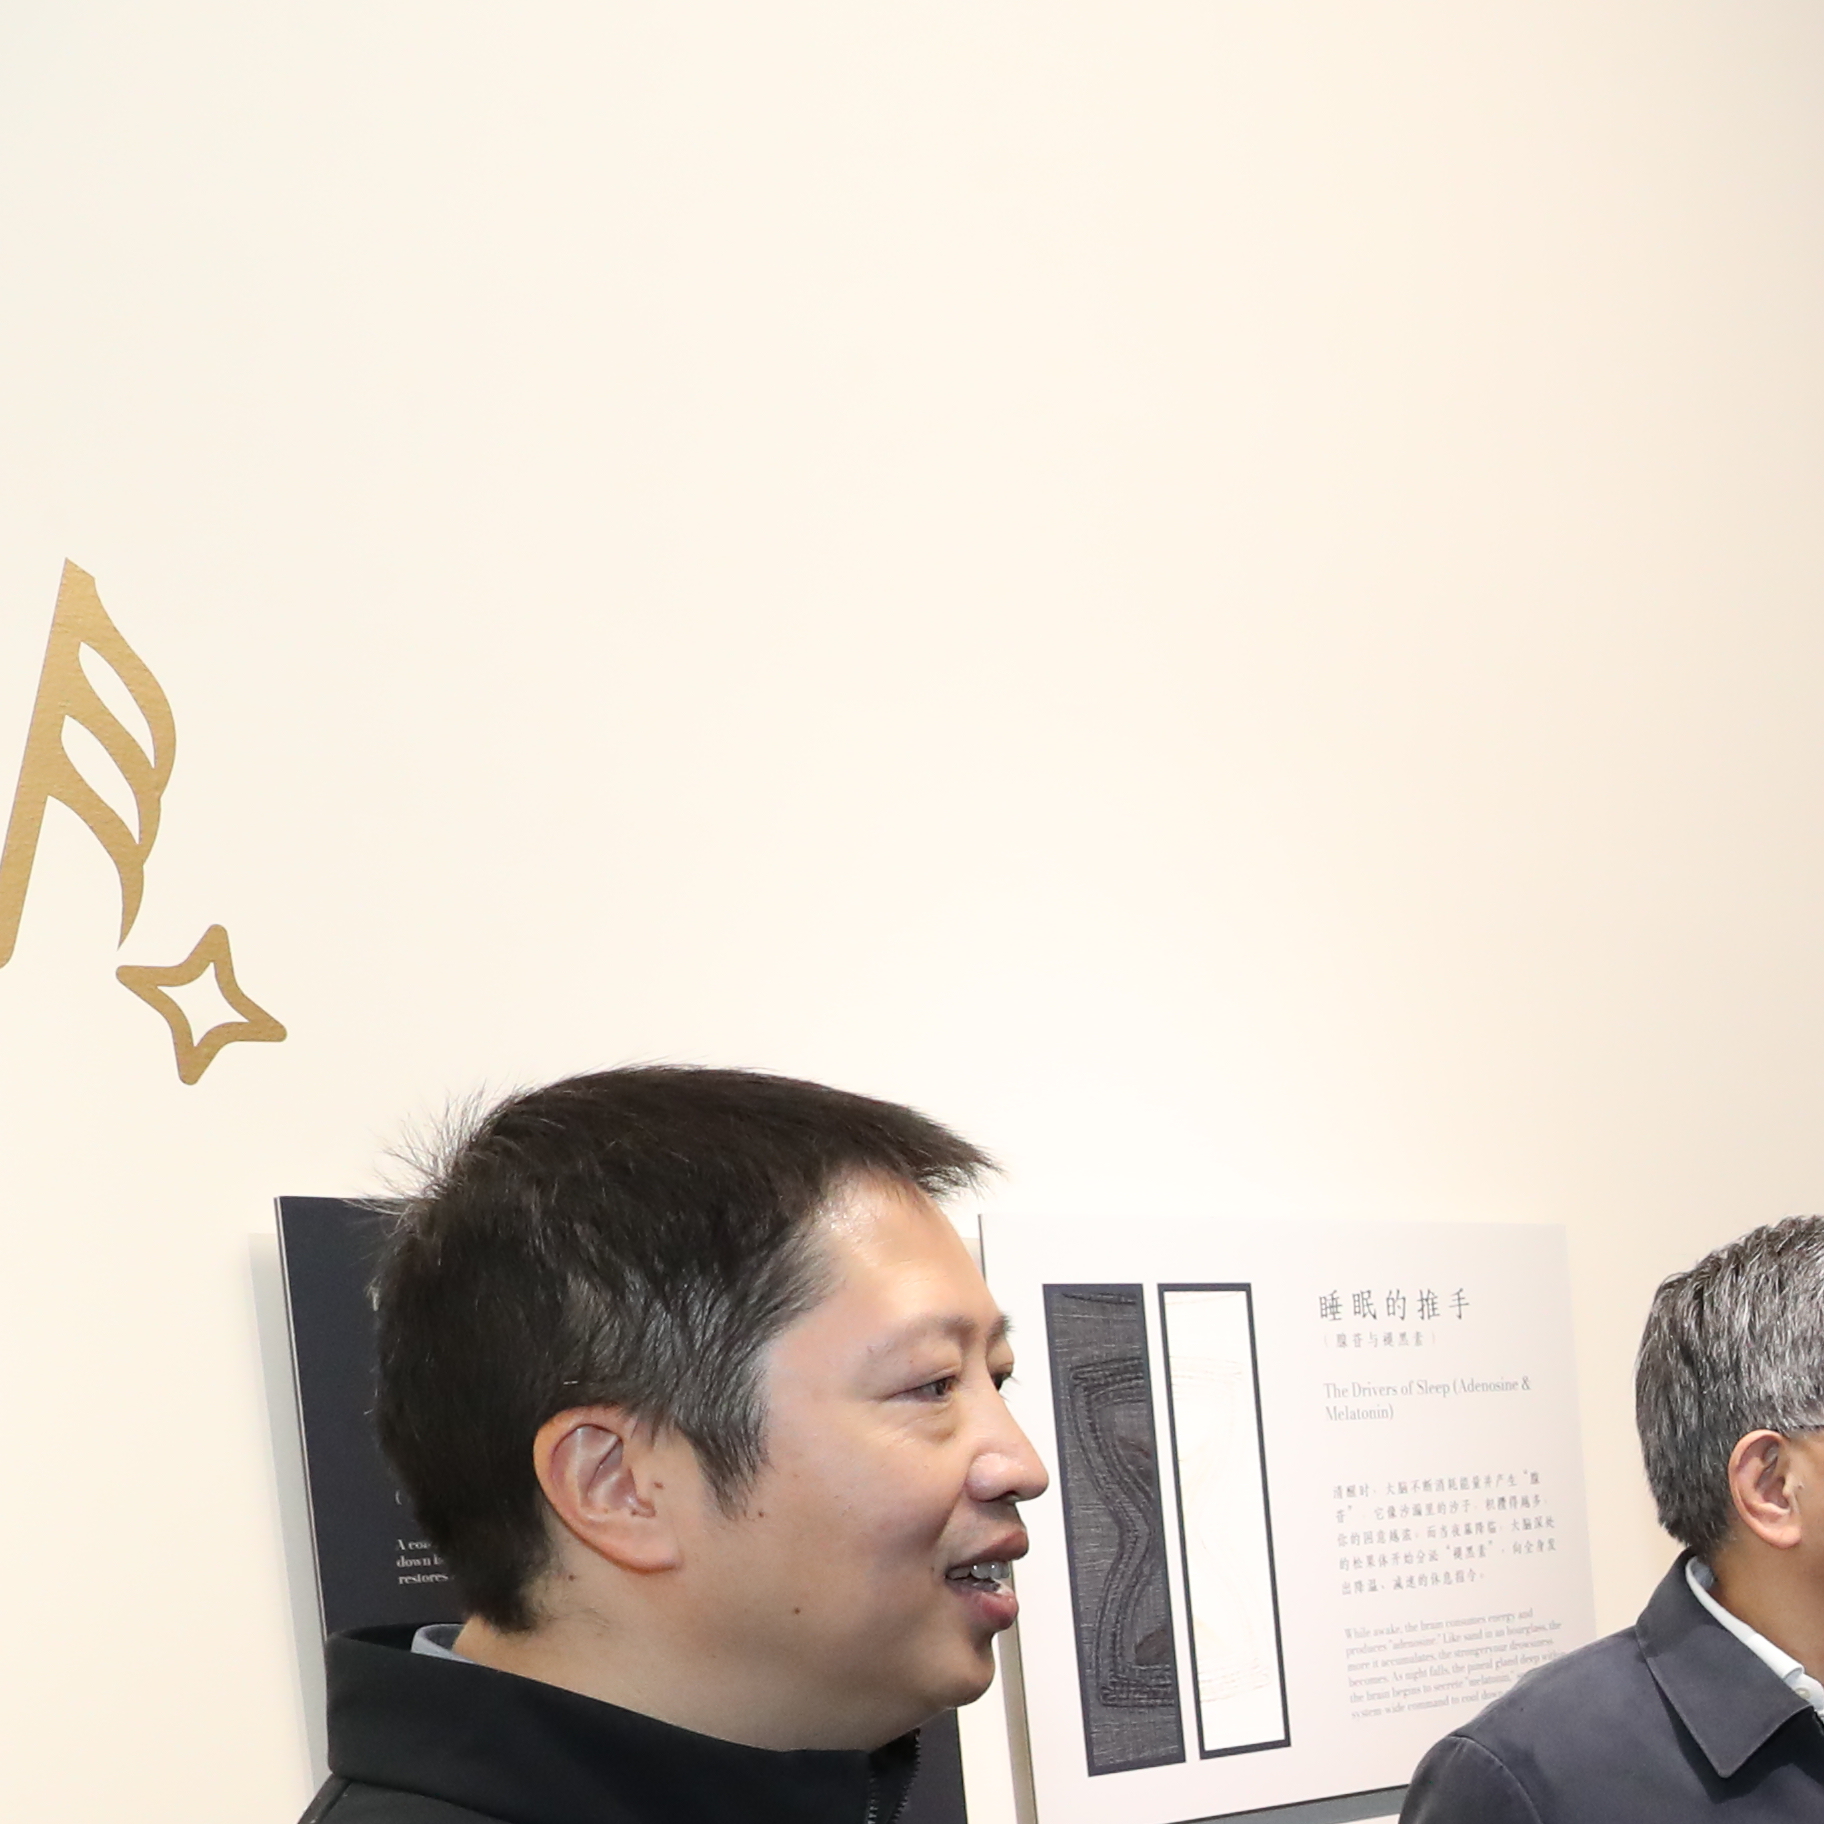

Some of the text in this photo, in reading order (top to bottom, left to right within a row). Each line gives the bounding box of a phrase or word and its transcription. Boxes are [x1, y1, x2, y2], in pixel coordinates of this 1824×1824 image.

[1318, 1287, 1470, 1321] 睡眠的推手
[1323, 1375, 1532, 1398] The Drivers of Sleep (Adenosine &
[1326, 1403, 1395, 1421] Melatonin)
